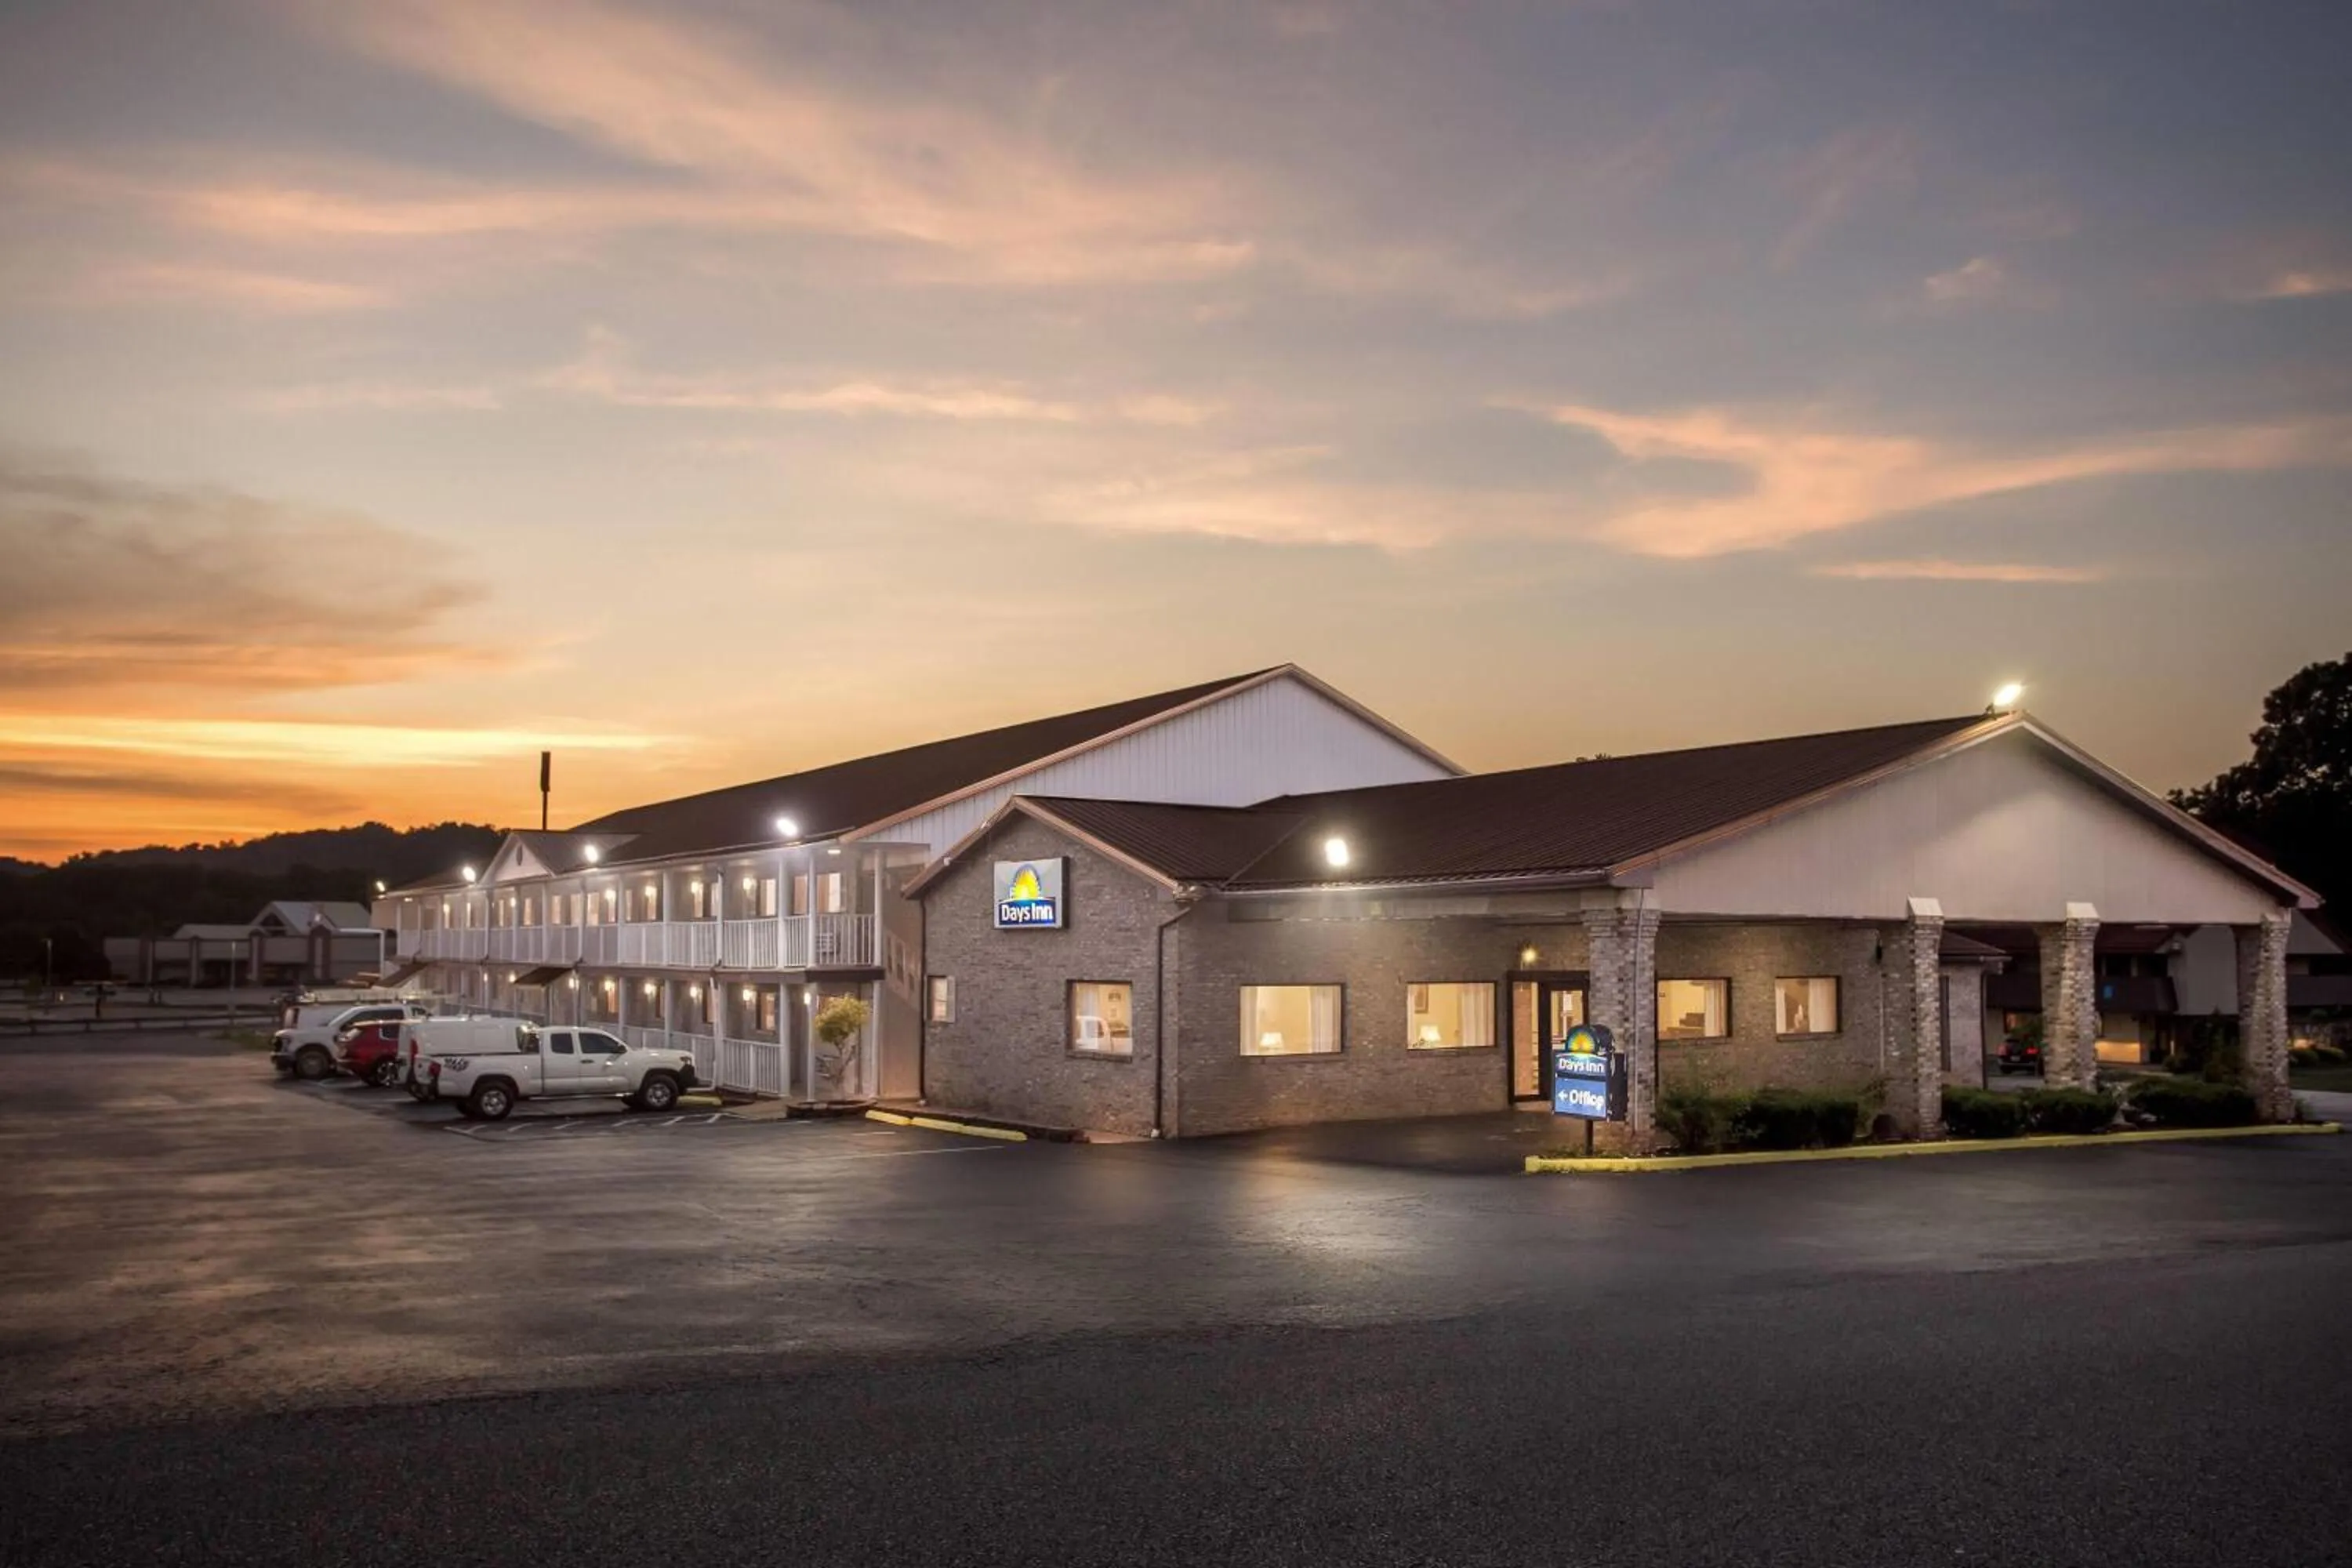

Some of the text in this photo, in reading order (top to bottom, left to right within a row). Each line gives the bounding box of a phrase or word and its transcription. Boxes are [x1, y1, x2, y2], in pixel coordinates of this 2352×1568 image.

[1001, 903, 1053, 922] Days Inn
[1558, 1058, 1604, 1073] Days Inn
